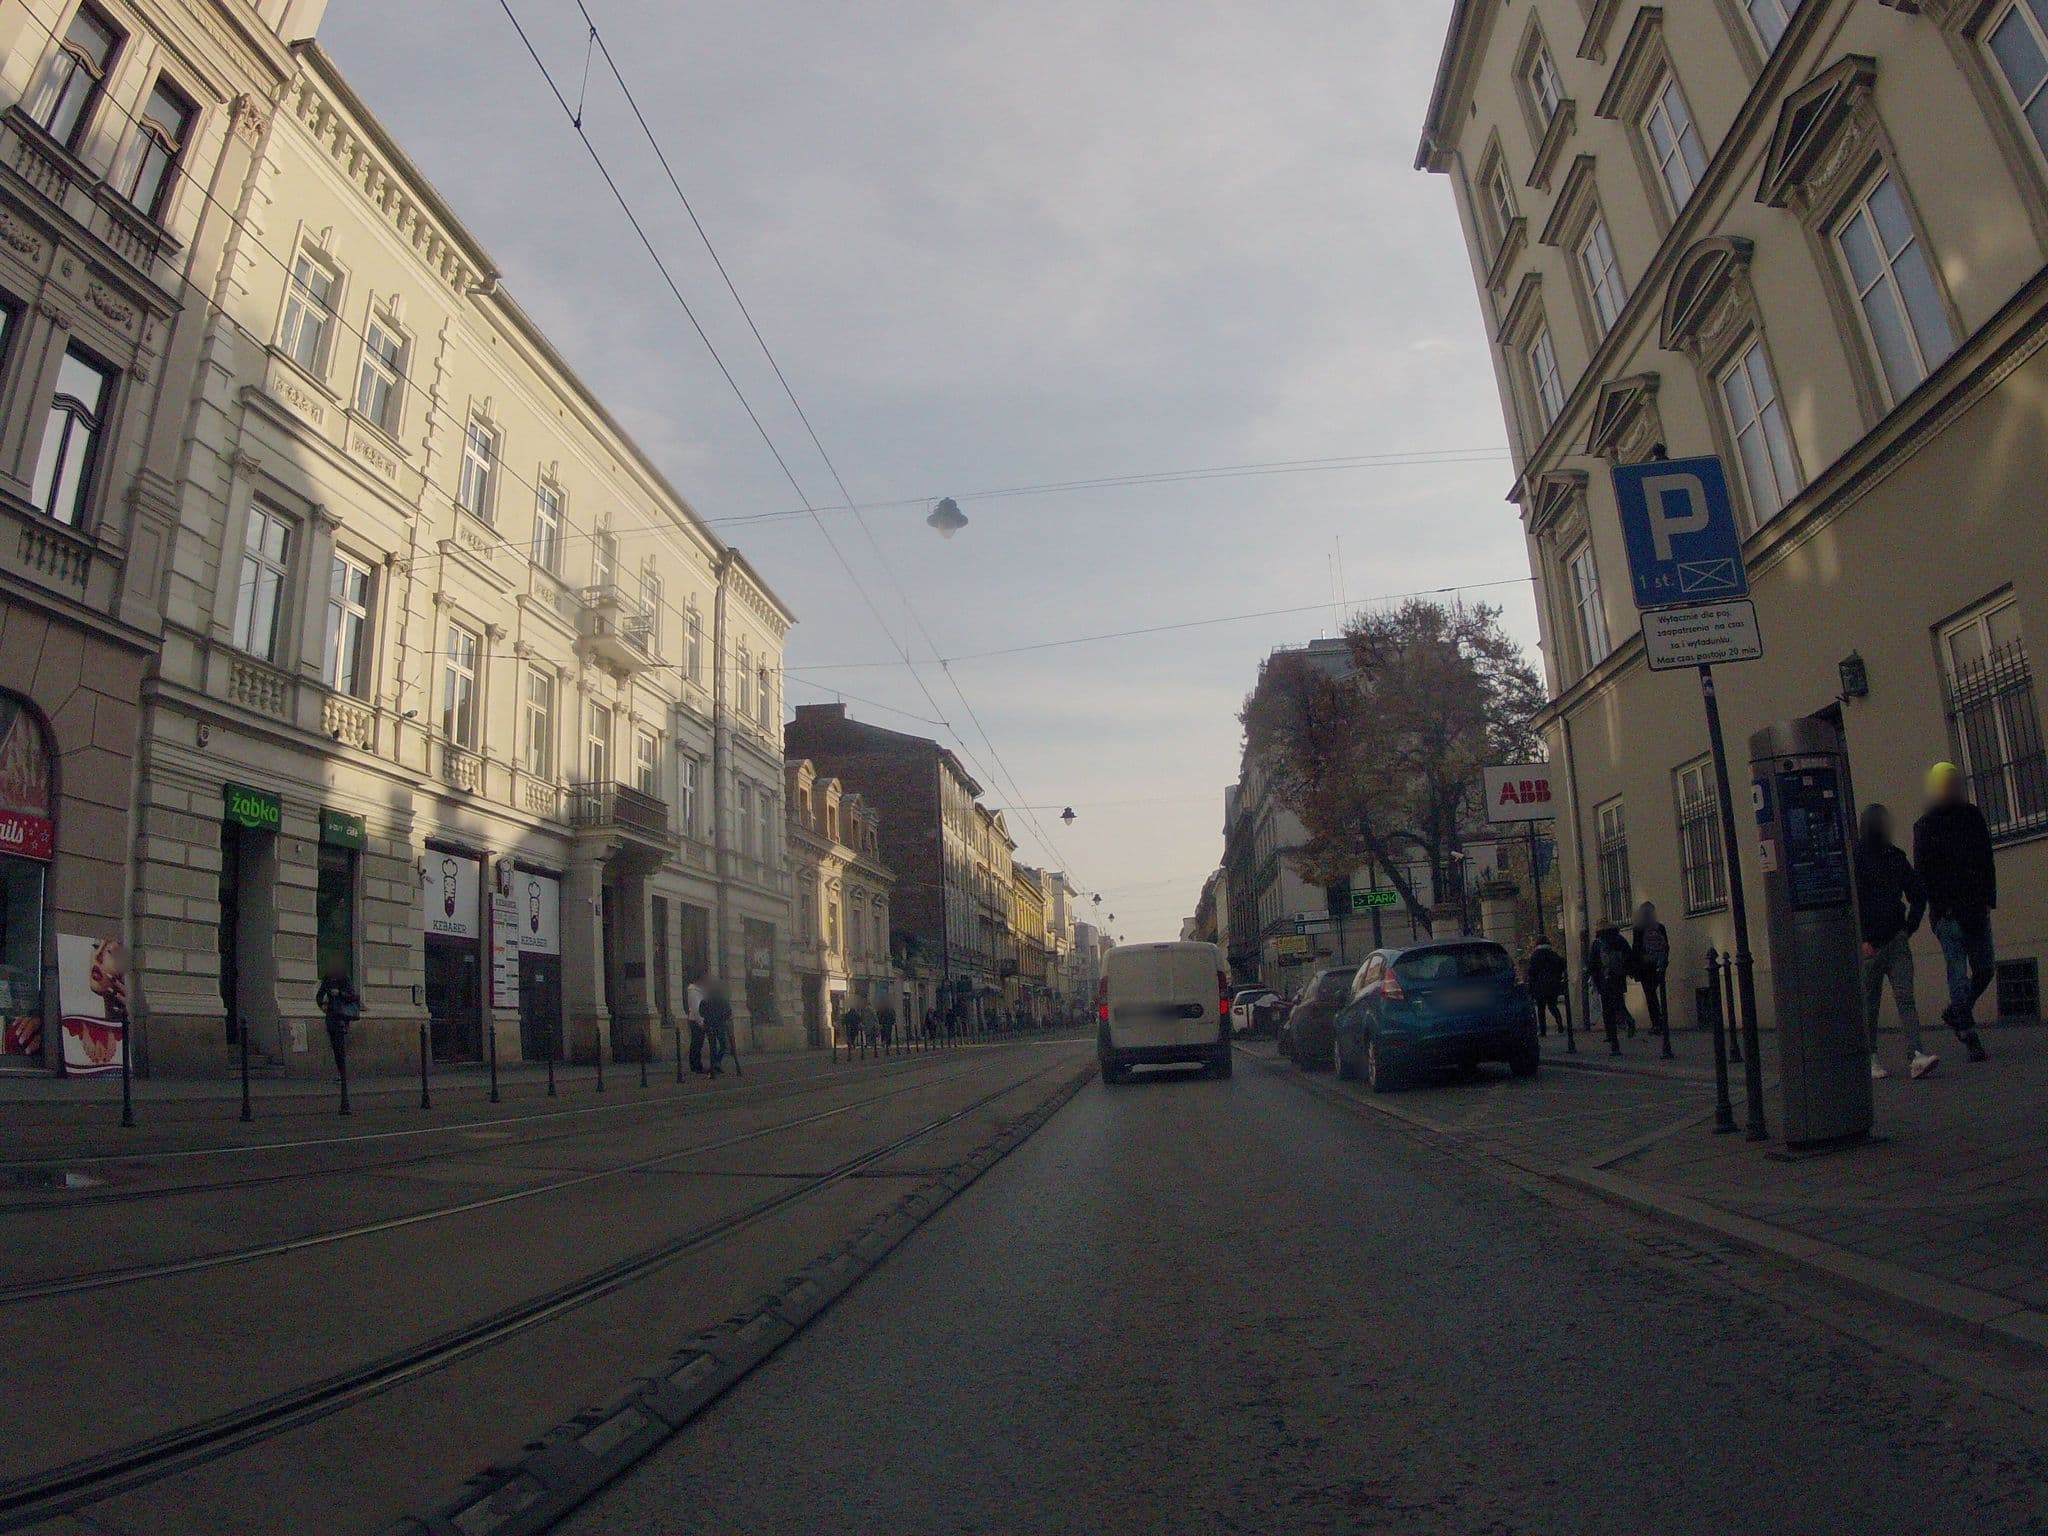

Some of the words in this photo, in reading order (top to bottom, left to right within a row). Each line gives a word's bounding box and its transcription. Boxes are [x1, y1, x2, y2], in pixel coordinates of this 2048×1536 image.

[1641, 473, 1709, 561] P
[1639, 575, 1646, 590] 1
[1701, 611, 1714, 619] dla
[1727, 621, 1745, 629] czas
[1676, 654, 1694, 663] czas
[1696, 650, 1727, 661] postoju
[1729, 647, 1739, 656] 20
[1499, 779, 1552, 805] ABB
[232, 792, 279, 824] żabka
[1367, 892, 1397, 904] PARK
[433, 920, 467, 934] KEBABER
